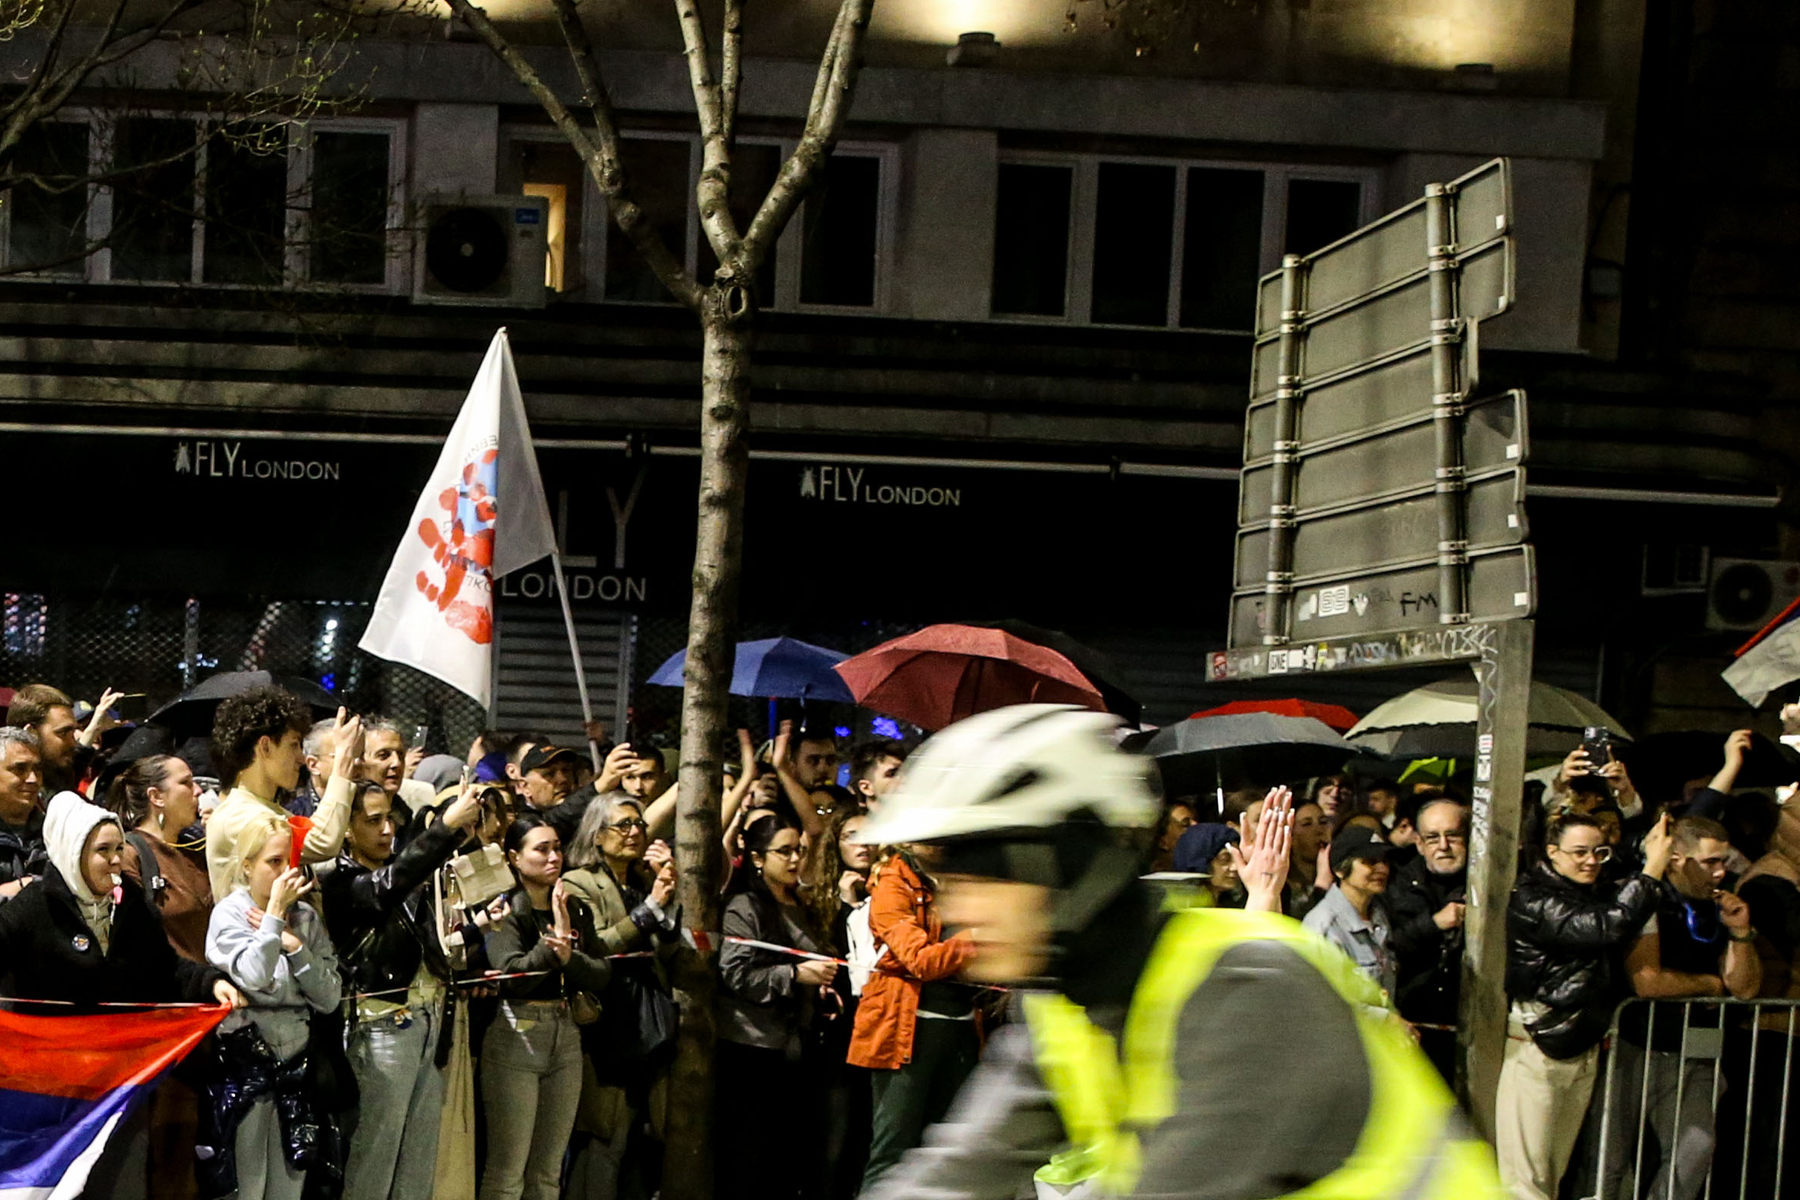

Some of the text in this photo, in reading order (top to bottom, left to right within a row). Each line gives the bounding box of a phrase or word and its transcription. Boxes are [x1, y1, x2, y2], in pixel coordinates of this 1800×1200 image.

[195, 441, 340, 480] FLY LONDON
[820, 466, 960, 506] FLY LONDON
[555, 464, 649, 569] LY
[502, 573, 647, 601] LONDON
